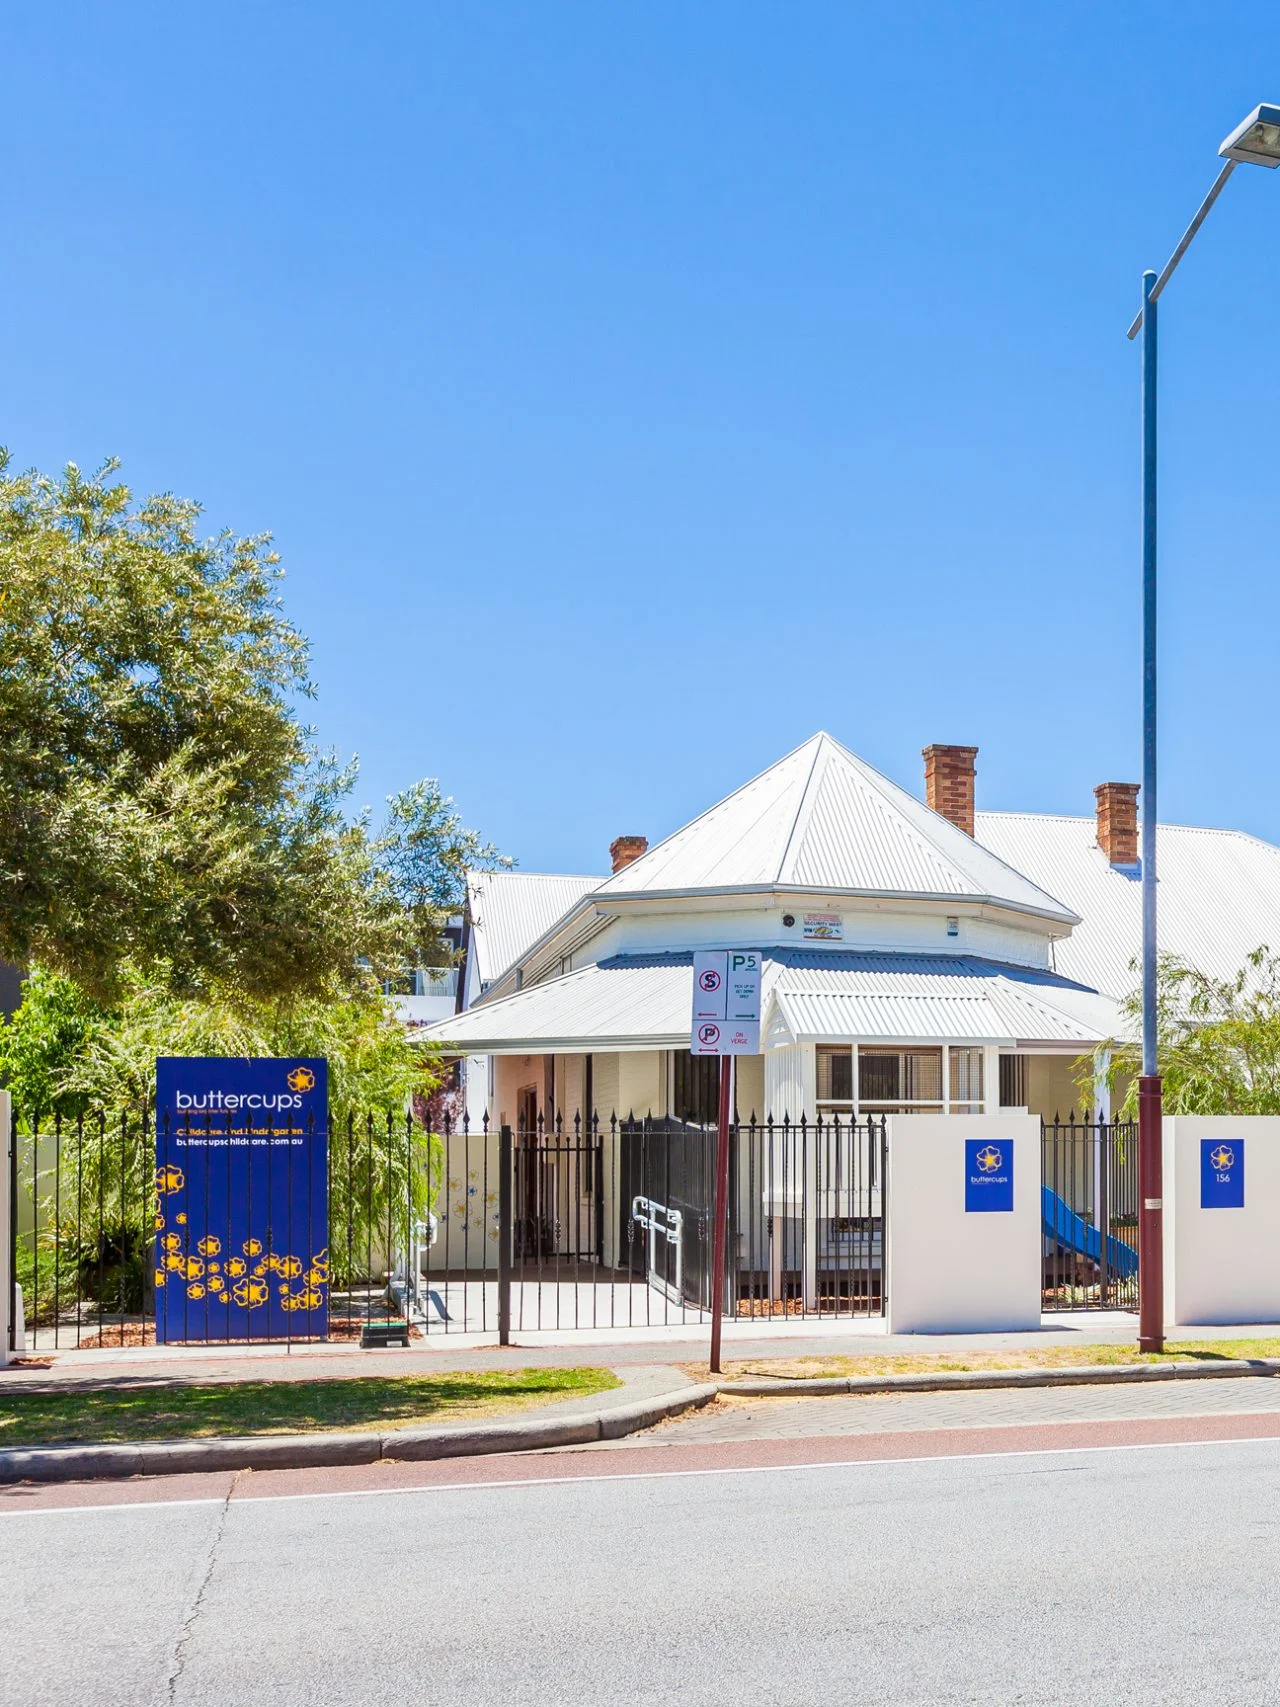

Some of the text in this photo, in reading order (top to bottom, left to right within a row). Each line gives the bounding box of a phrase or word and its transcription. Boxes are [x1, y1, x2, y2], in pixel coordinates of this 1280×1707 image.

[176, 1090, 303, 1112] buttercups
[971, 1176, 1008, 1184] buttercups
[1216, 1173, 1231, 1183] 156
